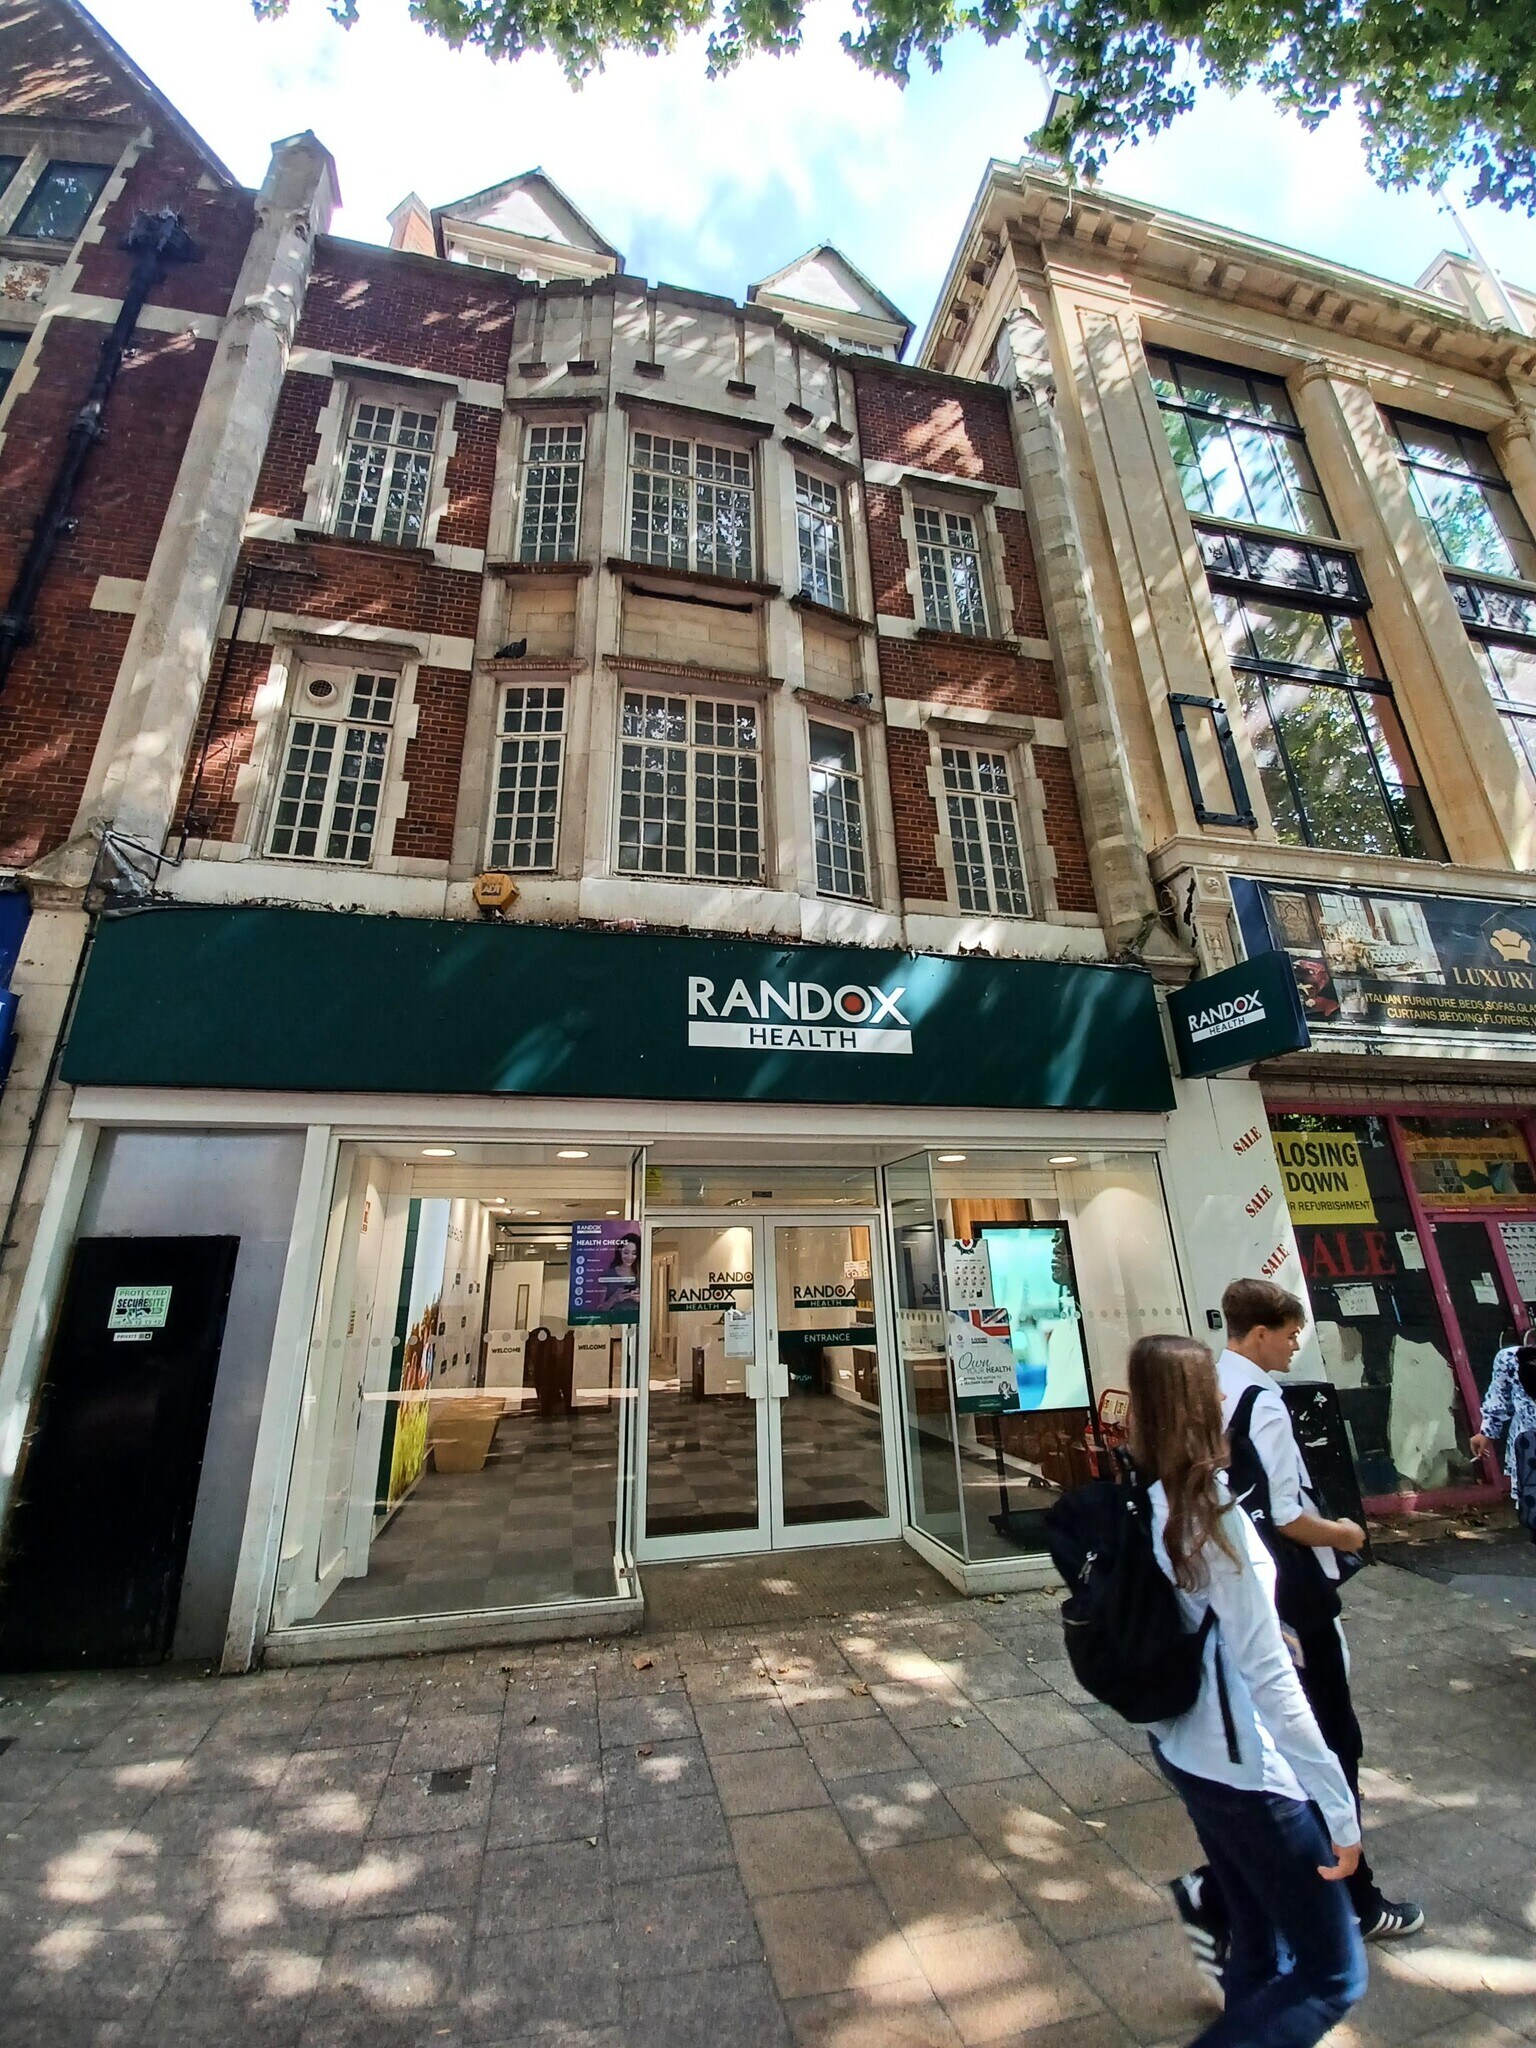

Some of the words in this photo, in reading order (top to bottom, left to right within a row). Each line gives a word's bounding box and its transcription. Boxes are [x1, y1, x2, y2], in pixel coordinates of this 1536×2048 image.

[1452, 966, 1535, 990] LUXURY
[688, 976, 911, 1025] RANDOX
[1364, 993, 1402, 1005] ITALIAN
[1187, 989, 1263, 1032] RANDOX
[1208, 1016, 1246, 1036] HEALTH
[749, 1026, 857, 1049] HEALTH
[1232, 1126, 1262, 1156] SALE
[1274, 1142, 1359, 1168] LOSING
[1245, 1184, 1274, 1218] SALE
[1298, 1200, 1370, 1212] REFURBISHMENT
[1261, 1243, 1290, 1279] SALE
[1299, 1231, 1397, 1278] ALE
[708, 1271, 753, 1283] RANDO
[668, 1288, 736, 1302] RANDOX
[685, 1303, 720, 1311] HEALTH
[804, 1332, 851, 1343] ENTRANCE
[958, 1352, 992, 1371] Own
[986, 1365, 1012, 1374] HEALTH
